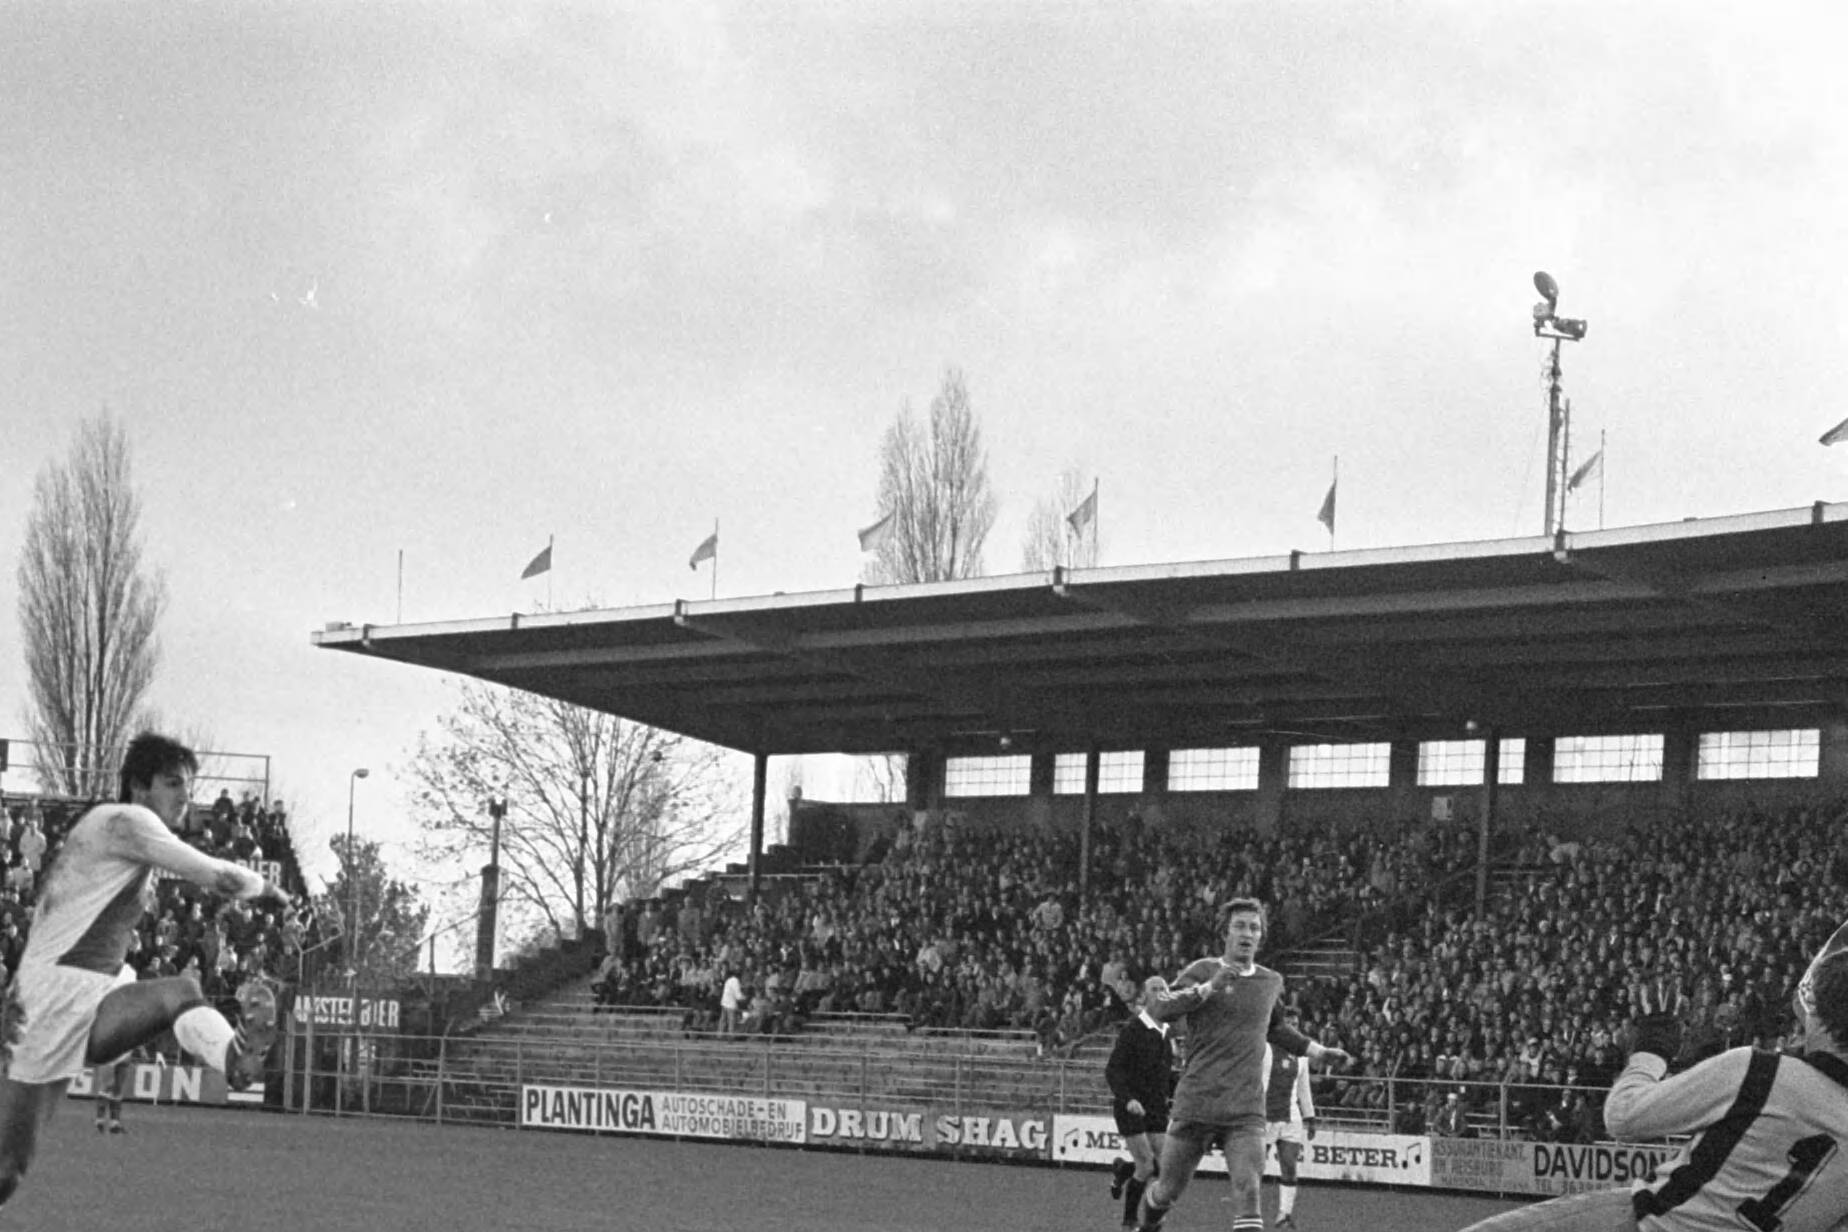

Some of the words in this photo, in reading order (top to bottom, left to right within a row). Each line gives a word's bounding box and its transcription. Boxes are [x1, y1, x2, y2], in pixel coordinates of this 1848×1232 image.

[360, 998, 399, 1027] BIER
[526, 1088, 656, 1130] PLANTINGA
[811, 1107, 923, 1142] DRUM
[936, 1115, 1049, 1149] SHAG
[1312, 1145, 1399, 1169] BETER
